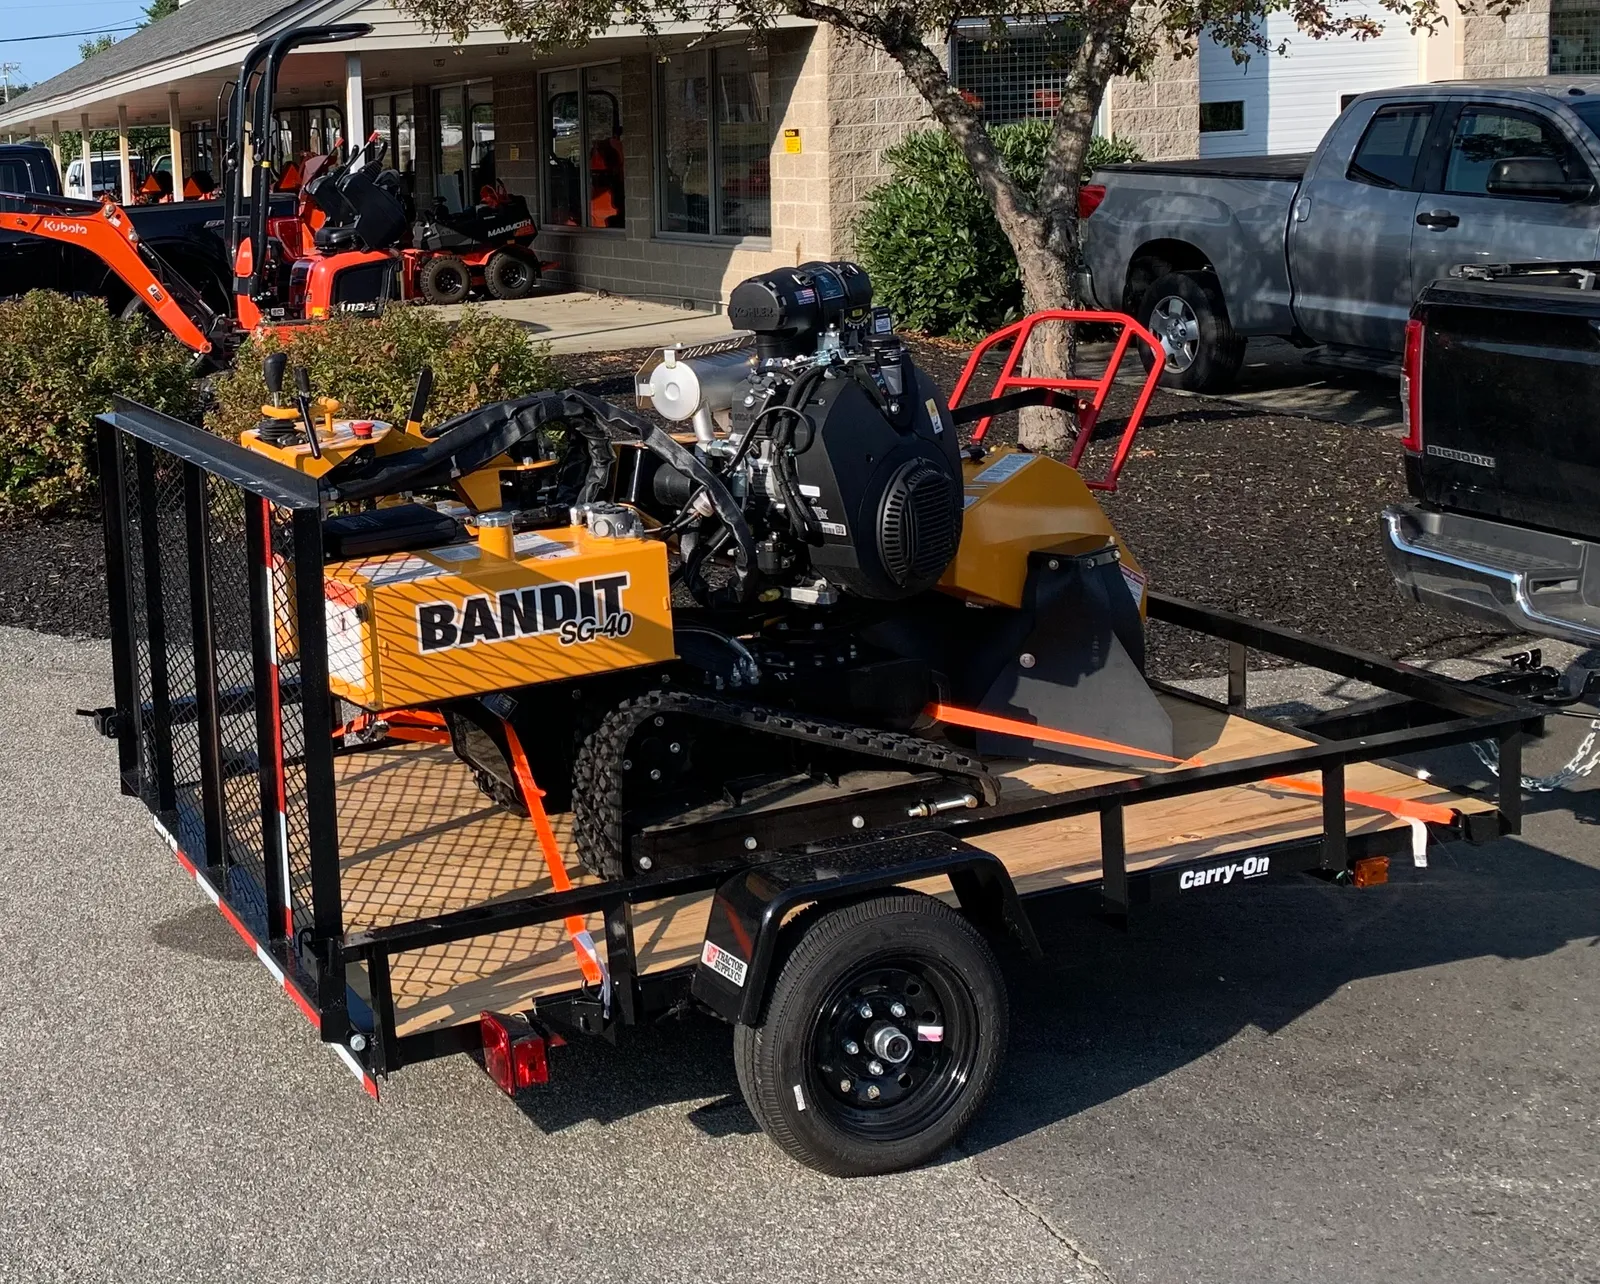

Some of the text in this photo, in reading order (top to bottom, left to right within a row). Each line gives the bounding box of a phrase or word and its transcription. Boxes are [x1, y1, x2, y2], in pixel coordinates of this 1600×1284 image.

[44, 220, 88, 235] Kubota
[487, 219, 532, 238] MAMMOTH
[734, 306, 774, 318] KOHLER
[1426, 445, 1496, 468] BIGHORN
[416, 571, 630, 654] BANDIT
[559, 612, 632, 646] SG-40
[1179, 856, 1270, 889] Carry-On
[713, 959, 736, 979] SUPPLY
[716, 949, 744, 974] TRACTOR
